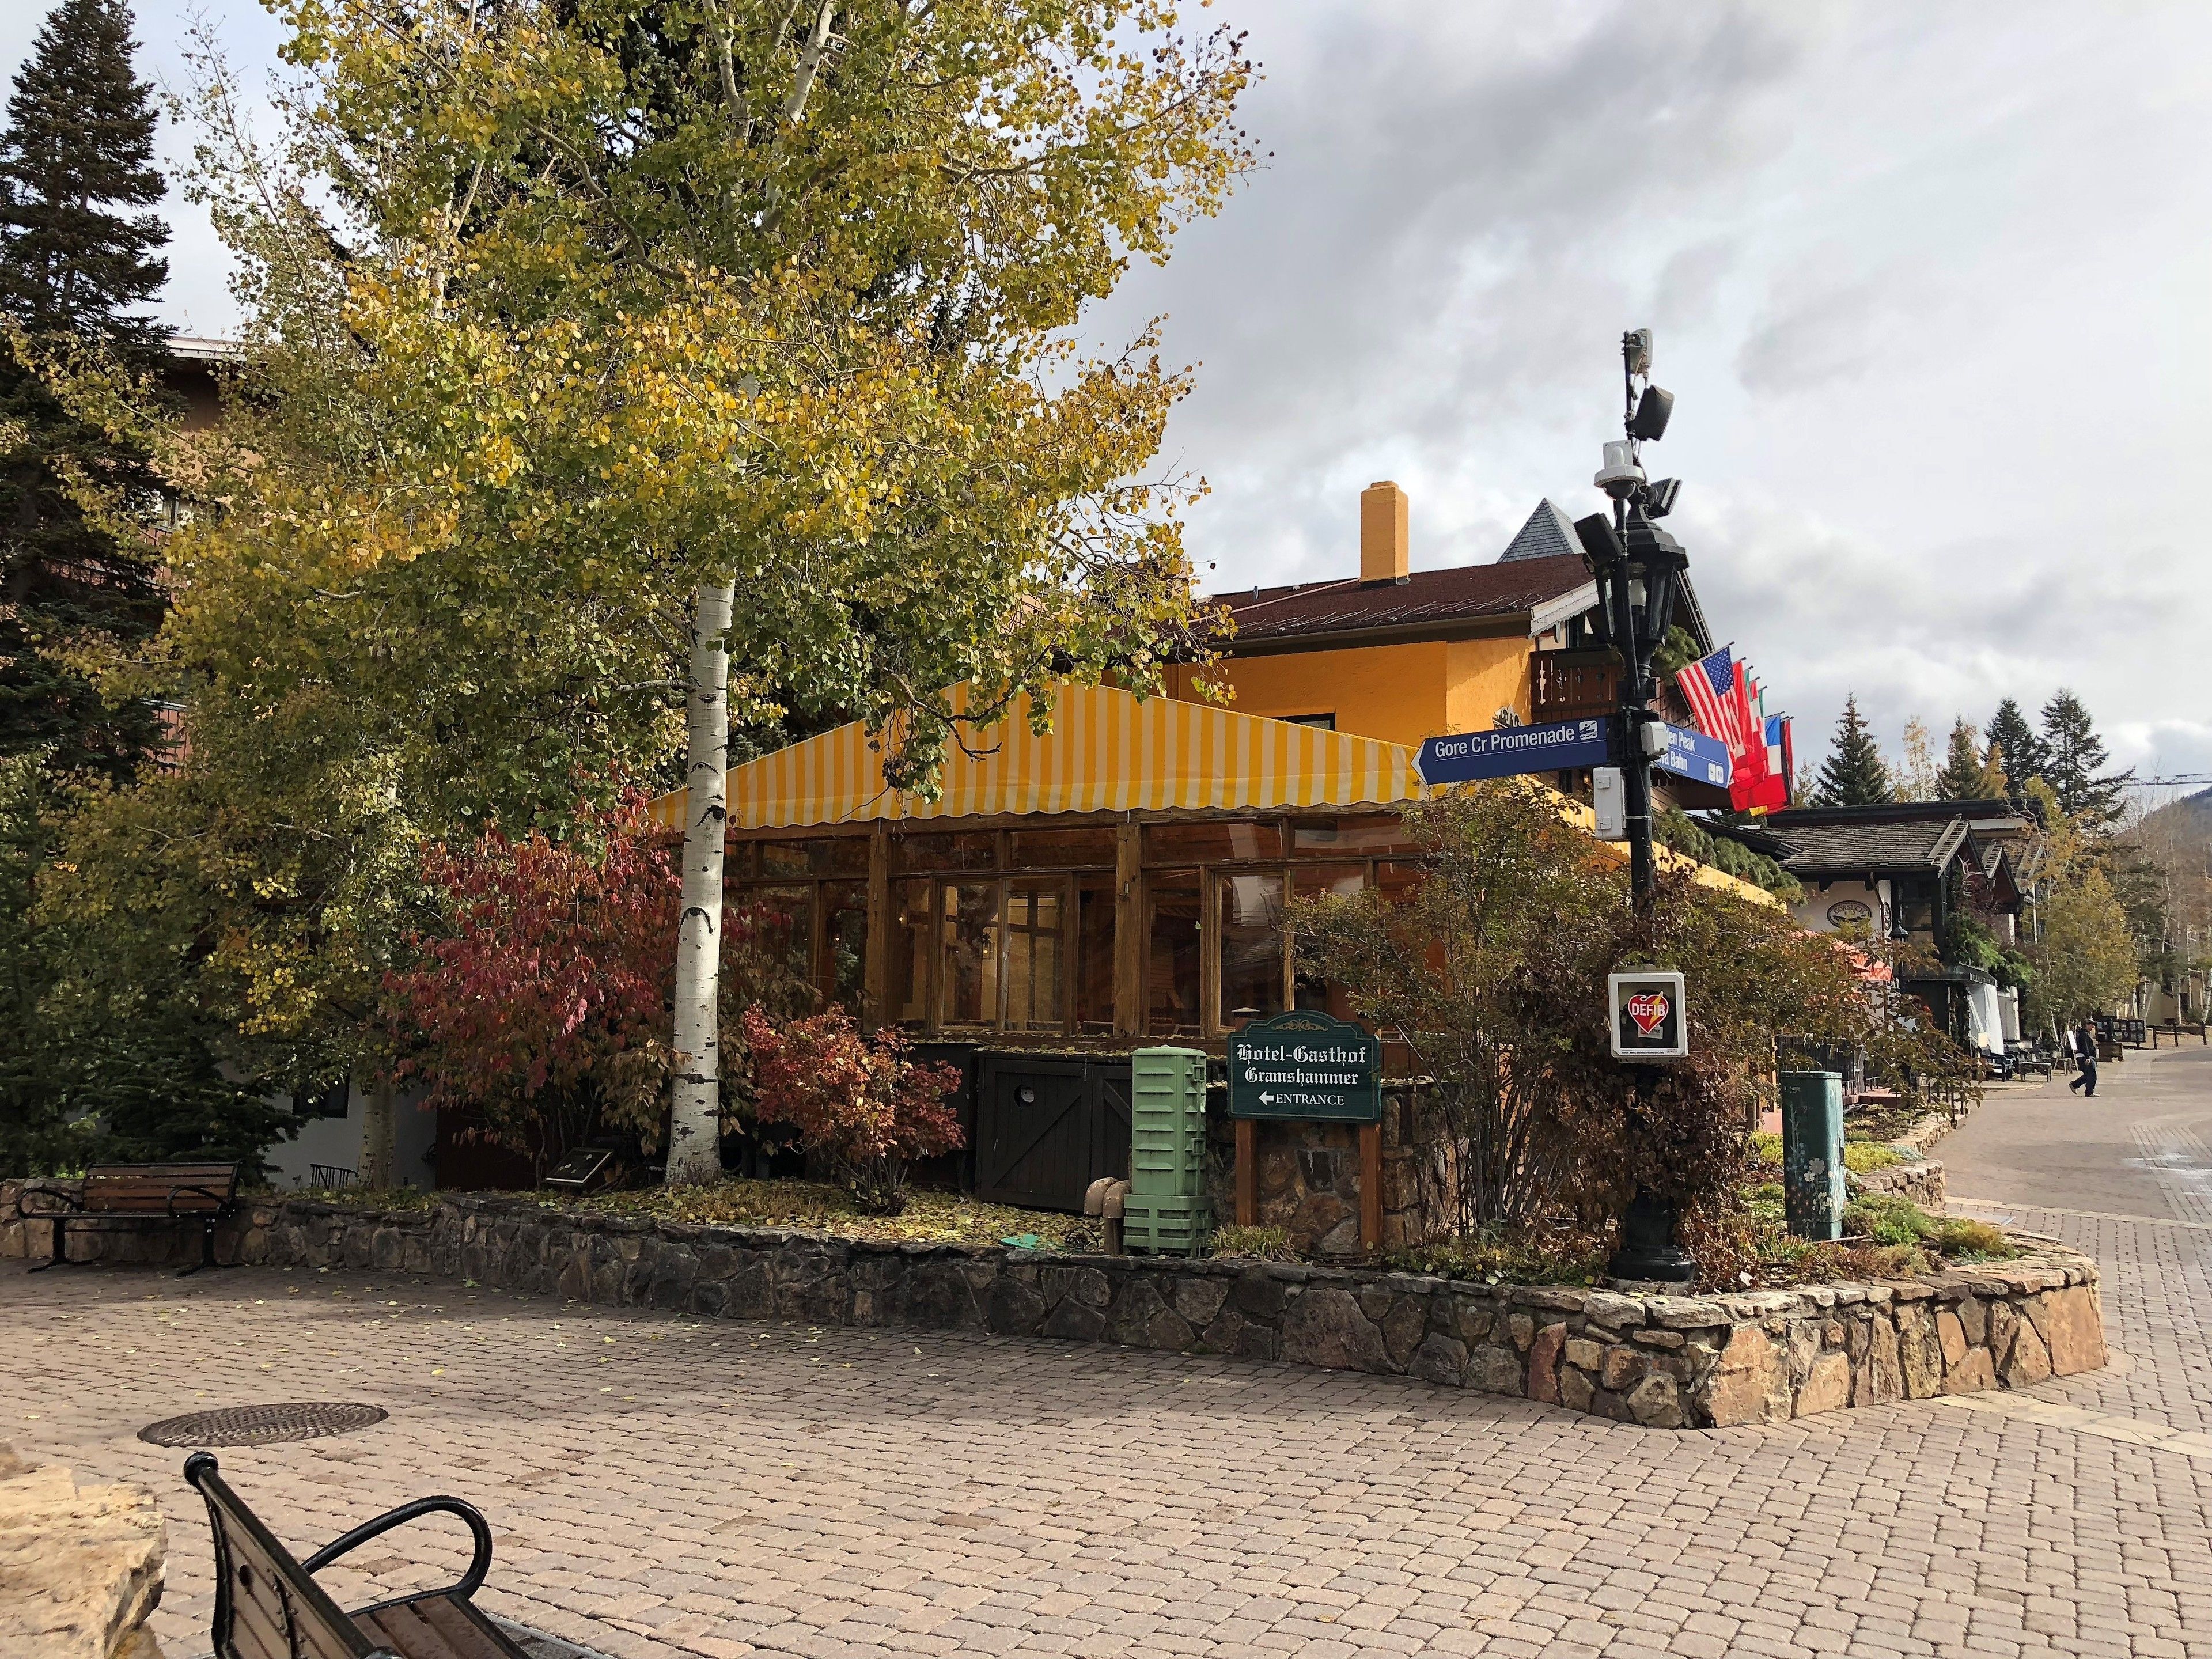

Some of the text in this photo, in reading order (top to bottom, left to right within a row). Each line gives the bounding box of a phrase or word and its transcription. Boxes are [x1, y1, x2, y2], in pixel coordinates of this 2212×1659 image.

[1435, 725, 1575, 758] Gore Cr Promenade
[1678, 730, 1696, 752] Peak
[1670, 750, 1688, 771] Bahn
[1631, 1003, 1665, 1017] DEFIB
[1237, 1043, 1366, 1067] Hotel-Gasthof
[1245, 1067, 1359, 1086] Gramshammer
[1275, 1093, 1344, 1105] ENTRANCE
